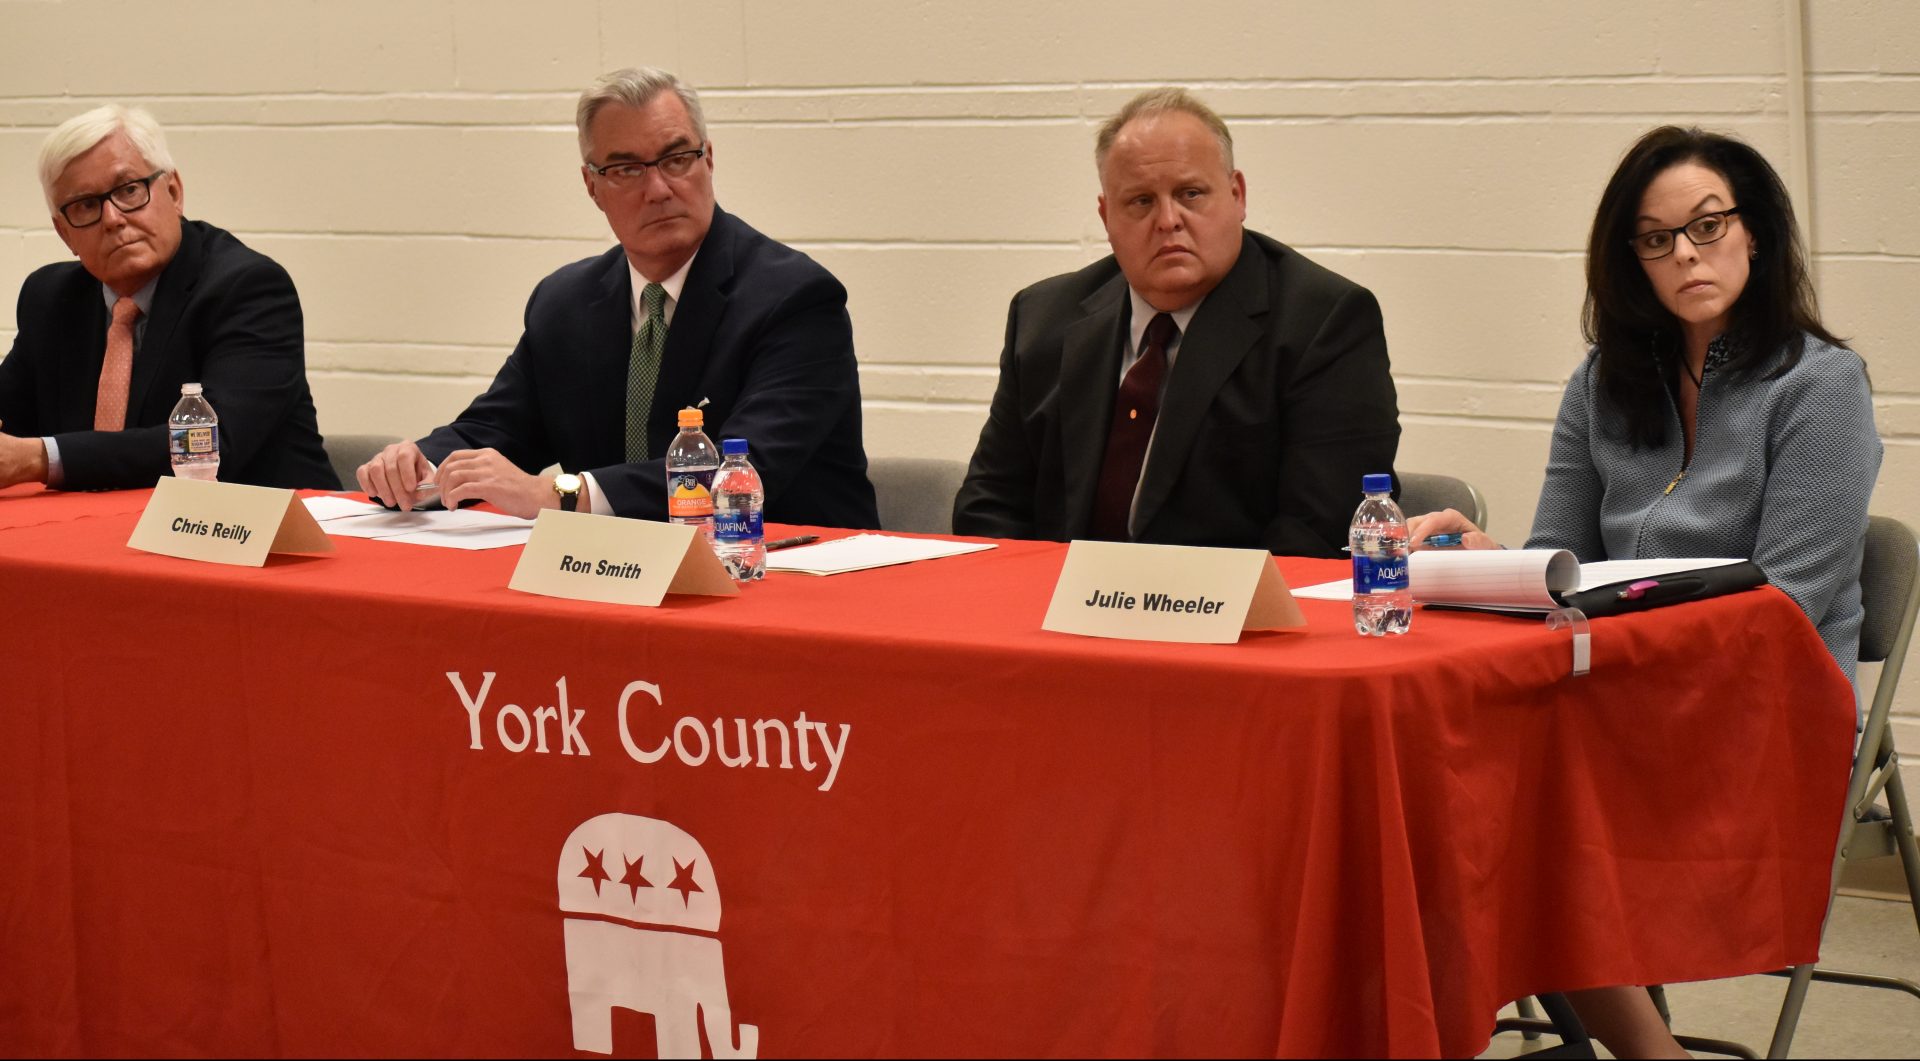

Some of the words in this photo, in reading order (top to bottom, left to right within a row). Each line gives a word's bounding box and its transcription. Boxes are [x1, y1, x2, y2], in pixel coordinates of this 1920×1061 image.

[676, 498, 707, 506] ORANGE
[171, 517, 209, 536] Chris
[211, 521, 252, 545] Reilly
[559, 554, 592, 574] Ron
[595, 559, 642, 580] Smith
[1085, 589, 1136, 610] Julie
[1143, 592, 1225, 615] Wheeler
[446, 671, 591, 756] York
[617, 680, 851, 792] County
